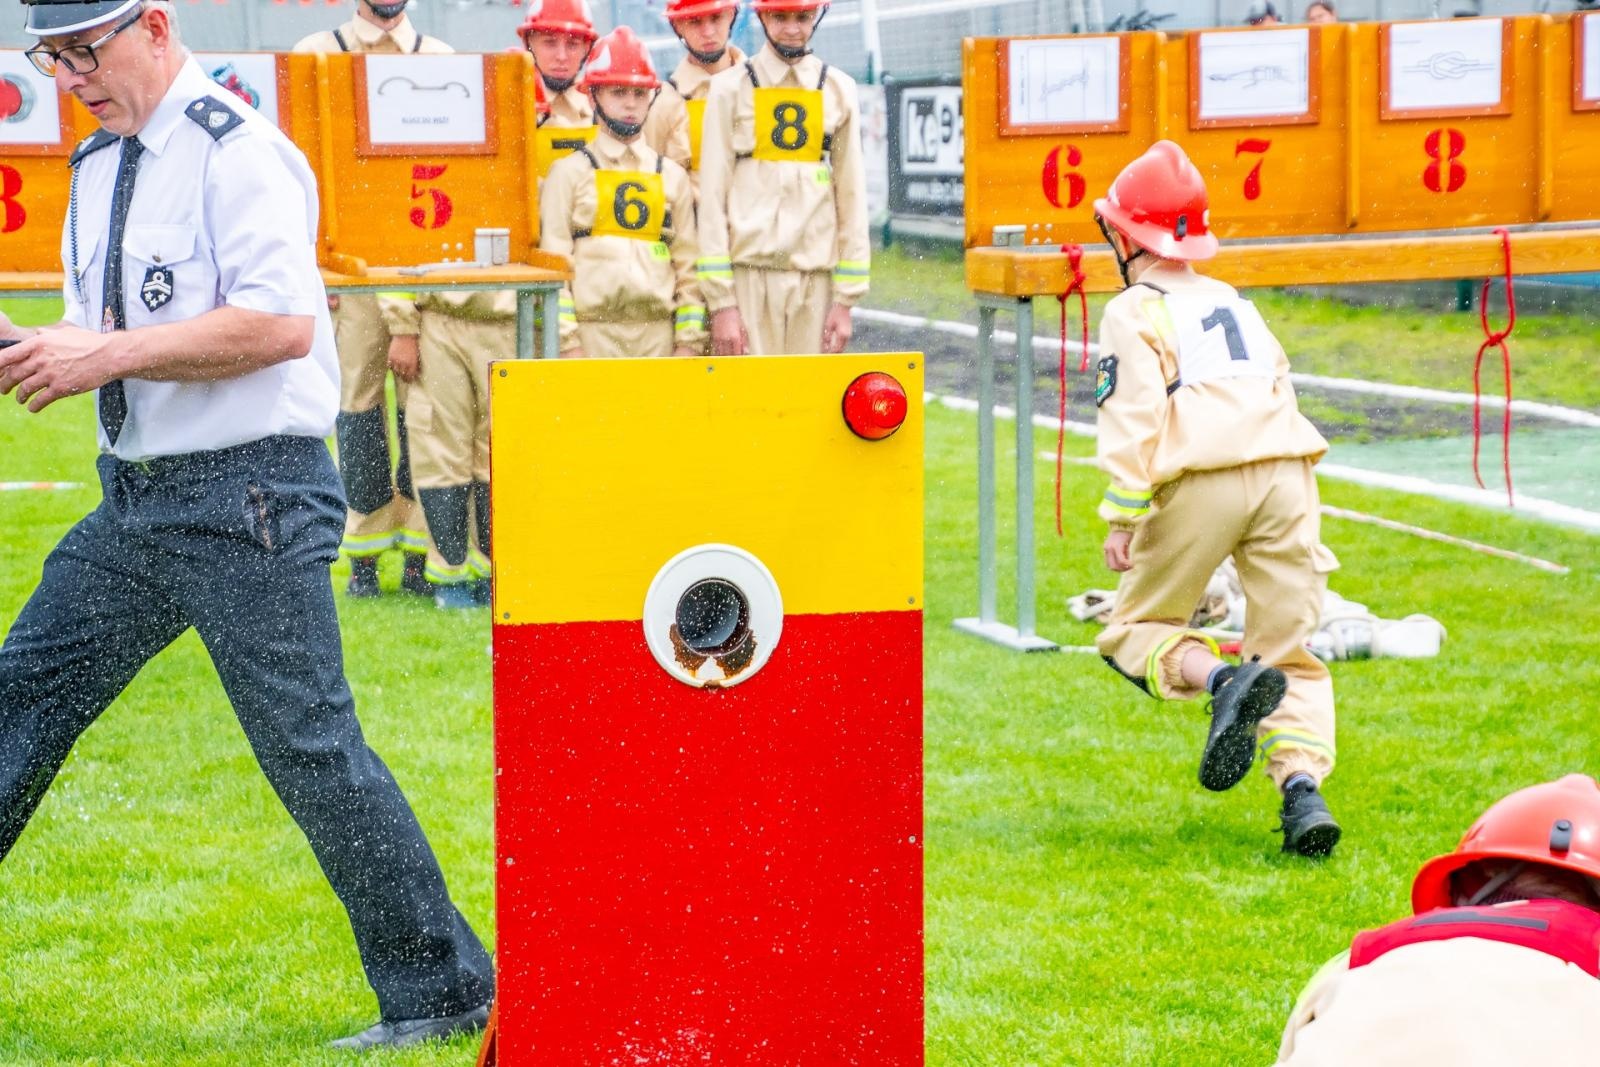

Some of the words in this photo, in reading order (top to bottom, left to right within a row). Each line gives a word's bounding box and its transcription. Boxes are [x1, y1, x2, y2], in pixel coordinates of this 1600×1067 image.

[771, 102, 808, 151] 8
[1042, 146, 1086, 209] 6
[1235, 139, 1271, 200] 7
[1423, 129, 1467, 193] 8
[409, 165, 453, 229] 5
[613, 182, 650, 230] 6
[1201, 308, 1249, 361] 1
